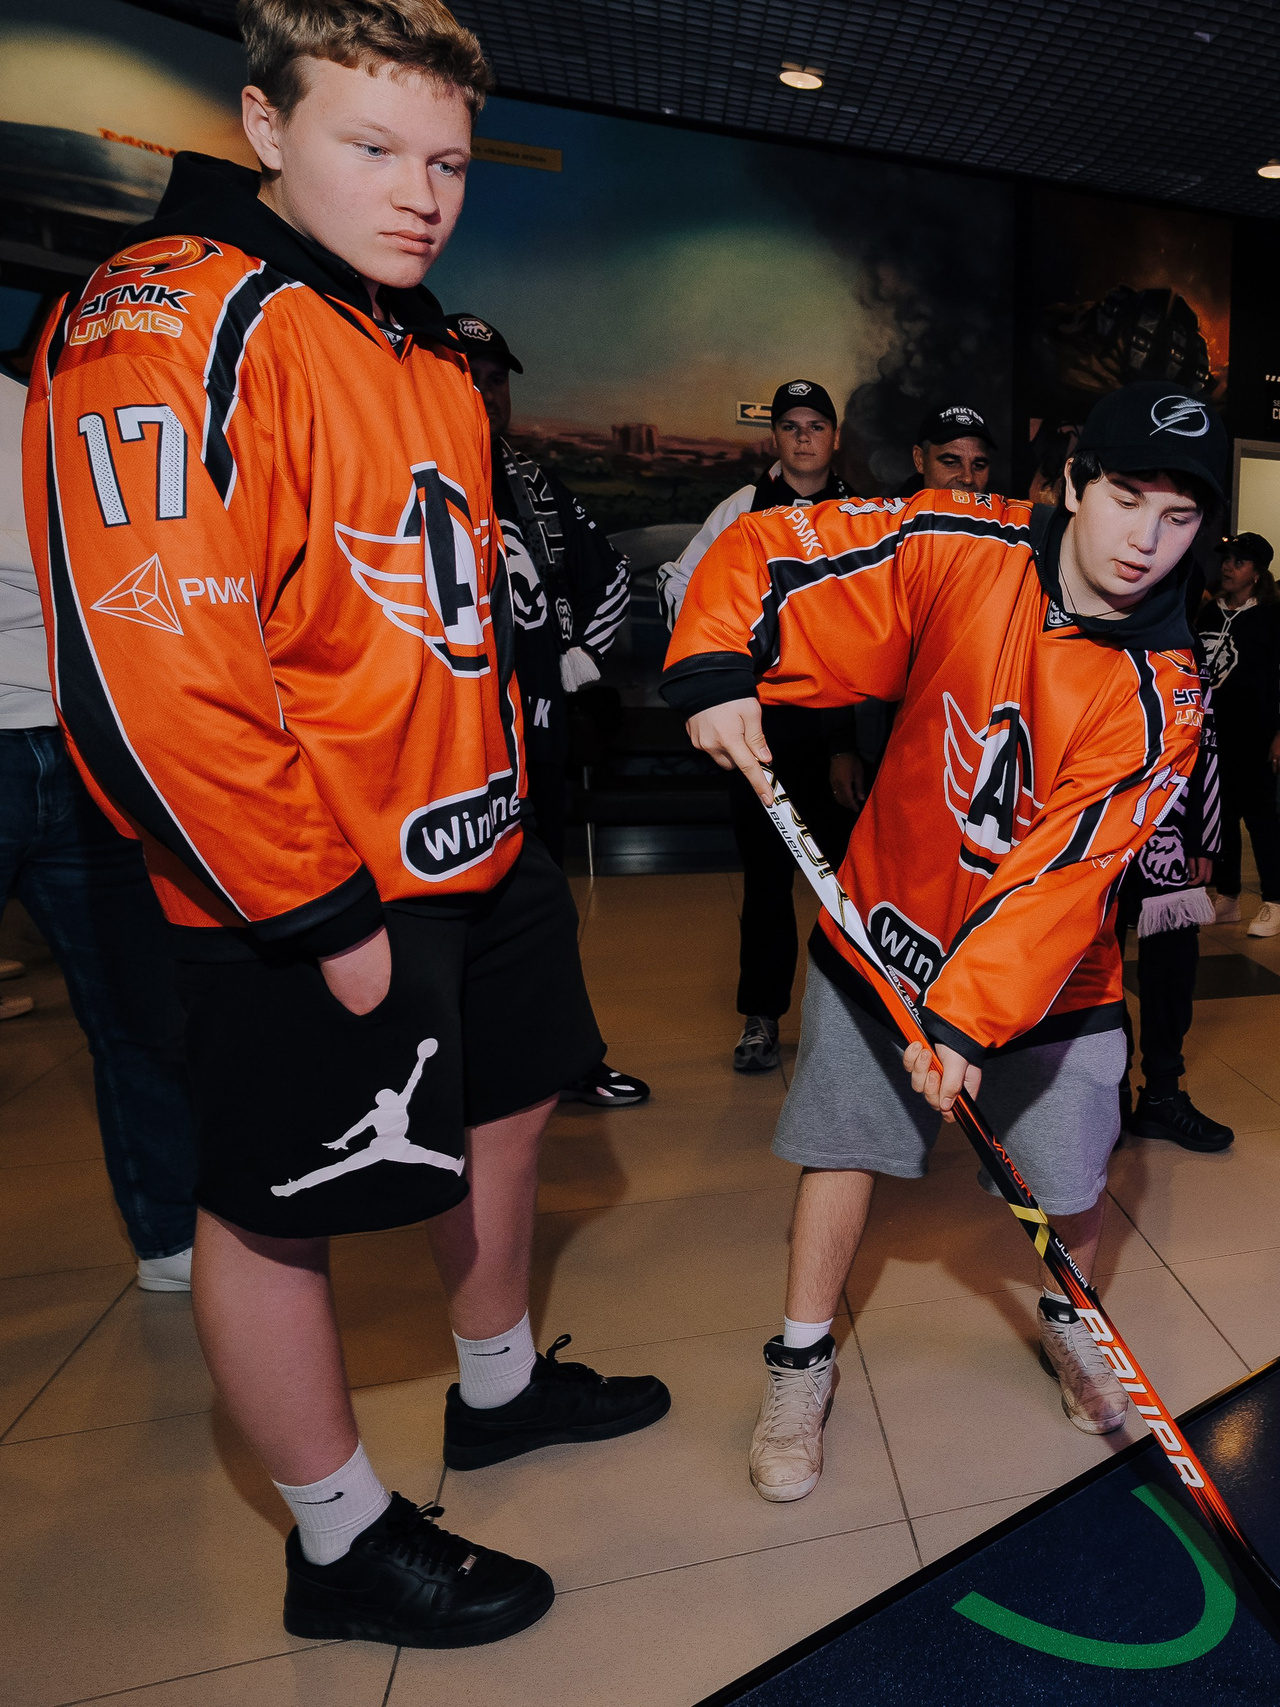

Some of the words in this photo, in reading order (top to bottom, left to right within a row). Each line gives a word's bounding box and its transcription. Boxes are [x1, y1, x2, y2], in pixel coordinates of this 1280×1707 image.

[68, 309, 184, 347] UMMC
[78, 403, 188, 529] 17
[1131, 764, 1189, 828] 17
[880, 916, 934, 983] Win
[992, 1135, 1032, 1198] VAPOR
[1055, 1237, 1089, 1290] JUNIOR
